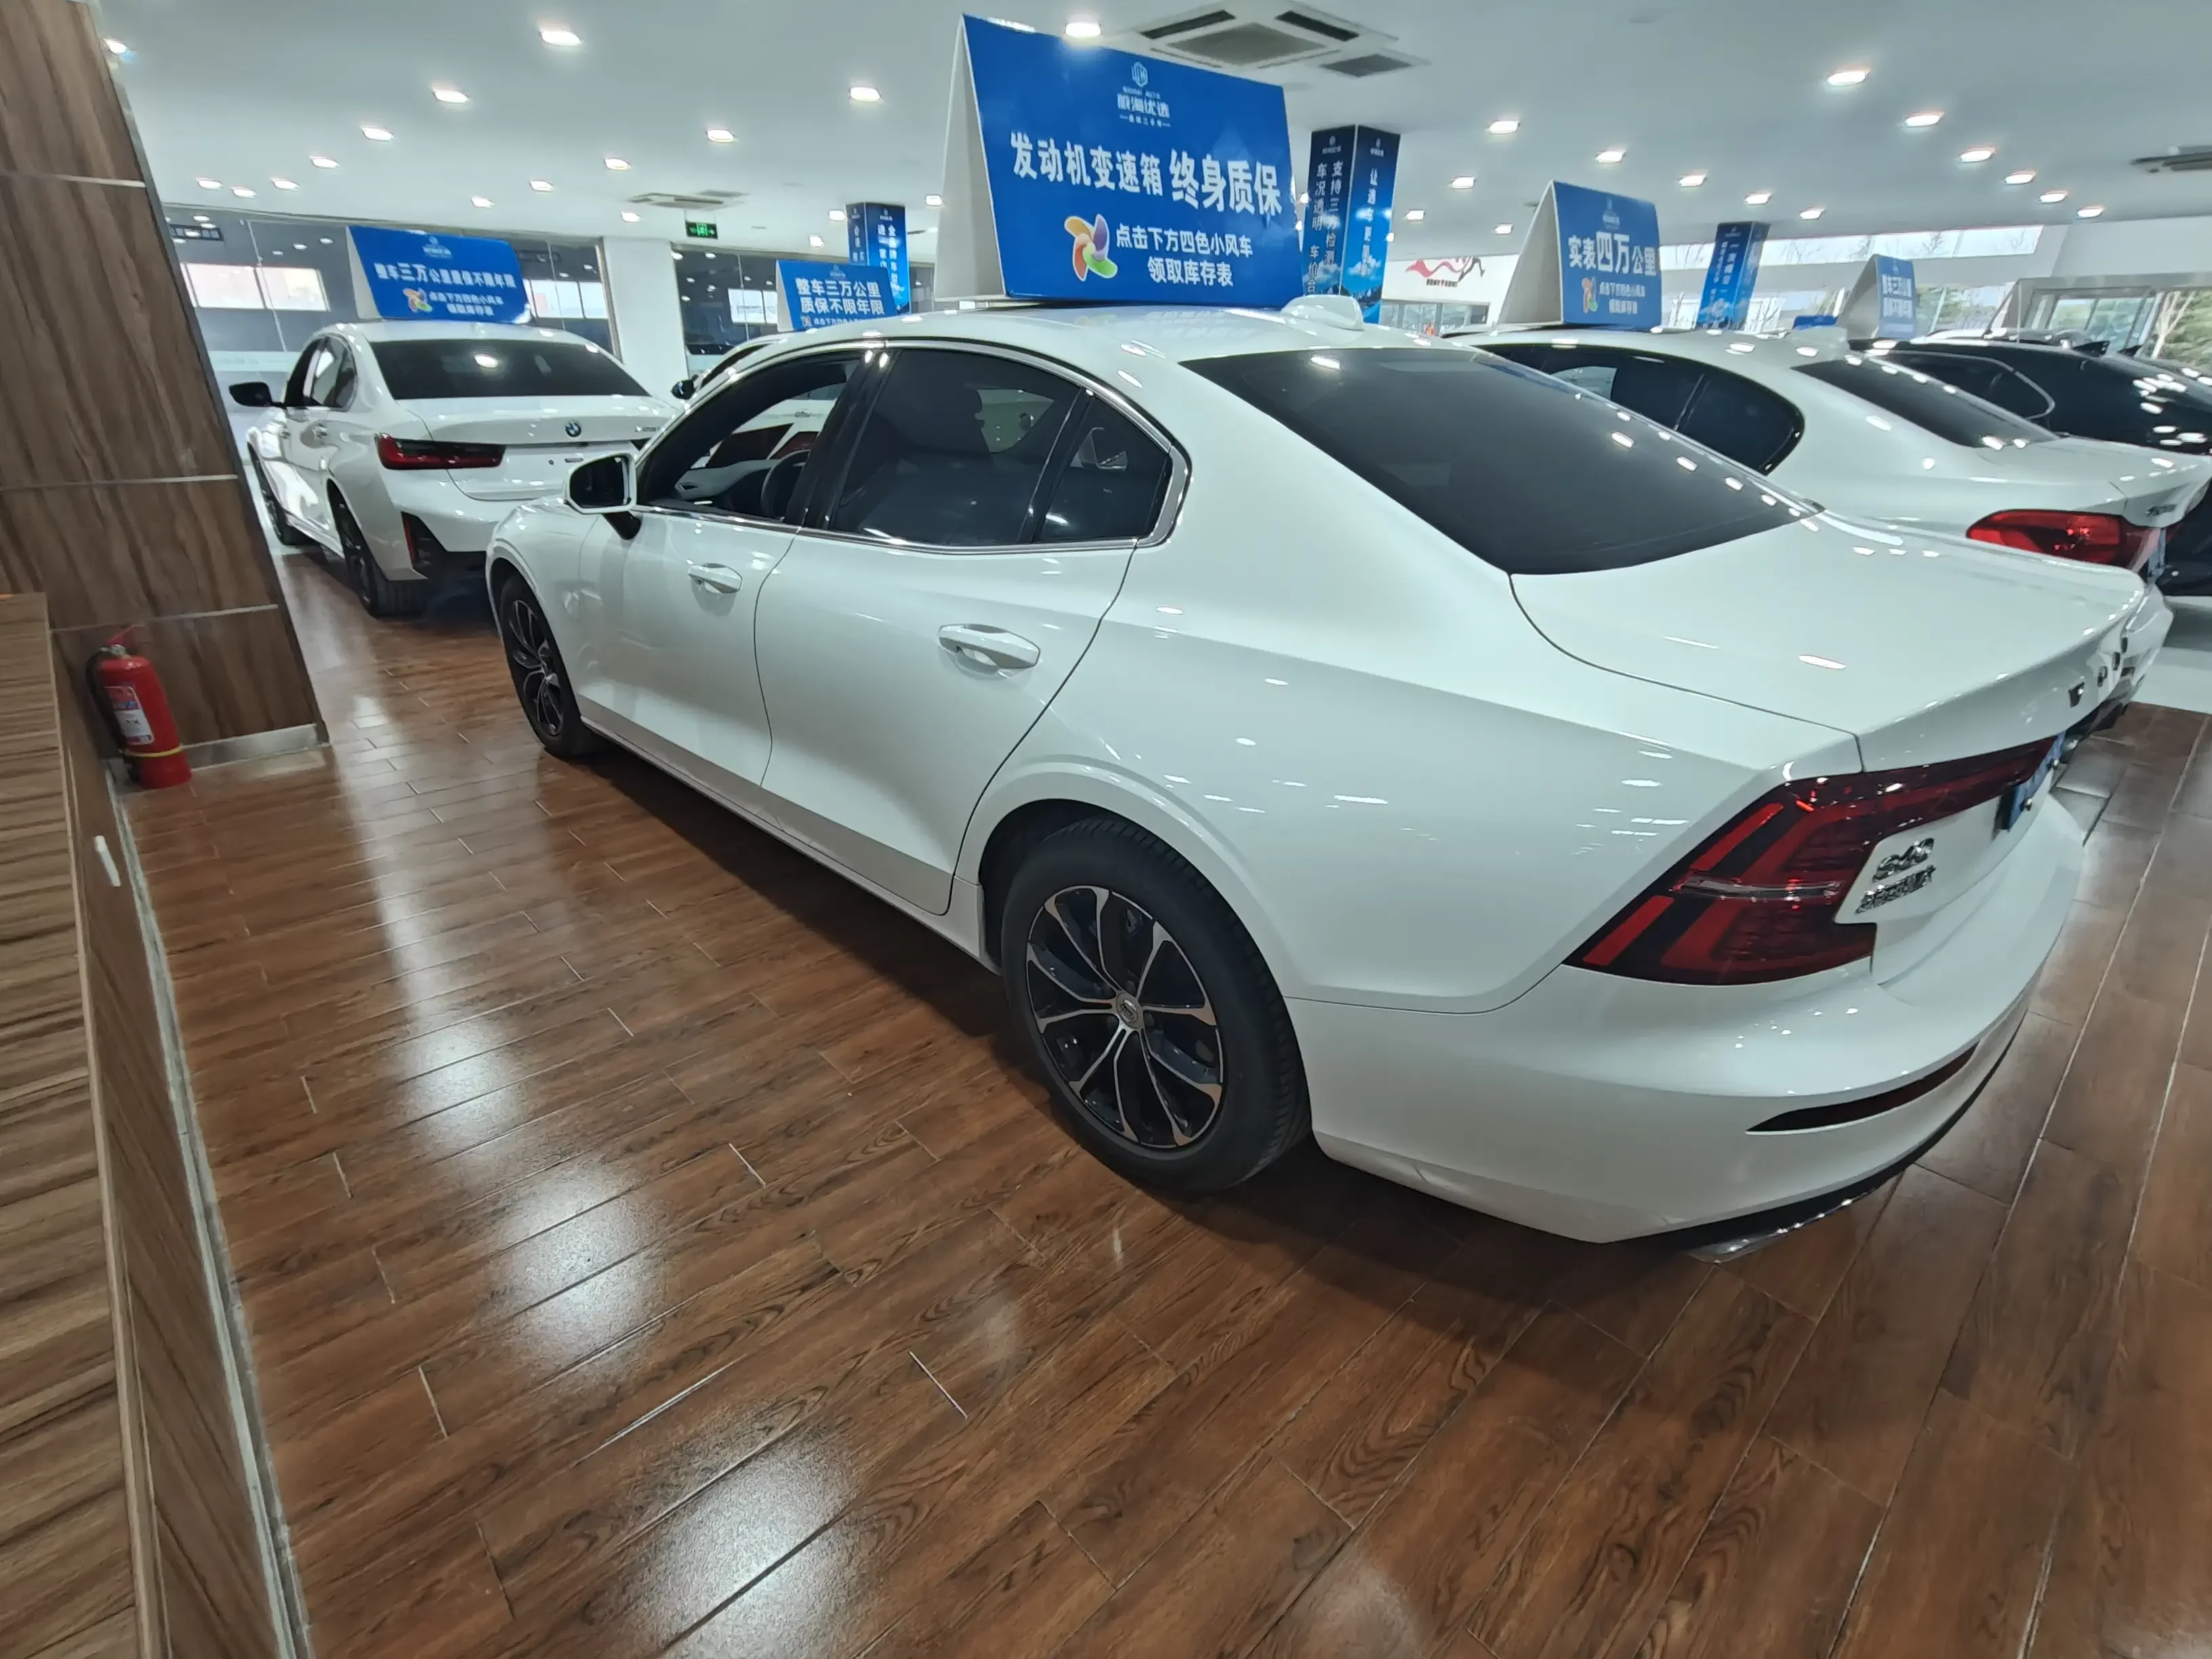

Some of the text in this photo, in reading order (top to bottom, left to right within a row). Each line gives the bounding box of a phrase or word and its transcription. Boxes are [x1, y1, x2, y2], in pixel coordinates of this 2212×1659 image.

[1010, 129, 1282, 216] 发动机变速箱 终身质保
[1311, 162, 1328, 232] 车况透明
[1116, 223, 1253, 258] 点击下方四色小风车
[1568, 230, 1656, 276] 实表四万公里
[795, 276, 882, 298] 整车三万公里
[1147, 255, 1233, 287] 领取库存表
[800, 296, 885, 316] 质保不限年限
